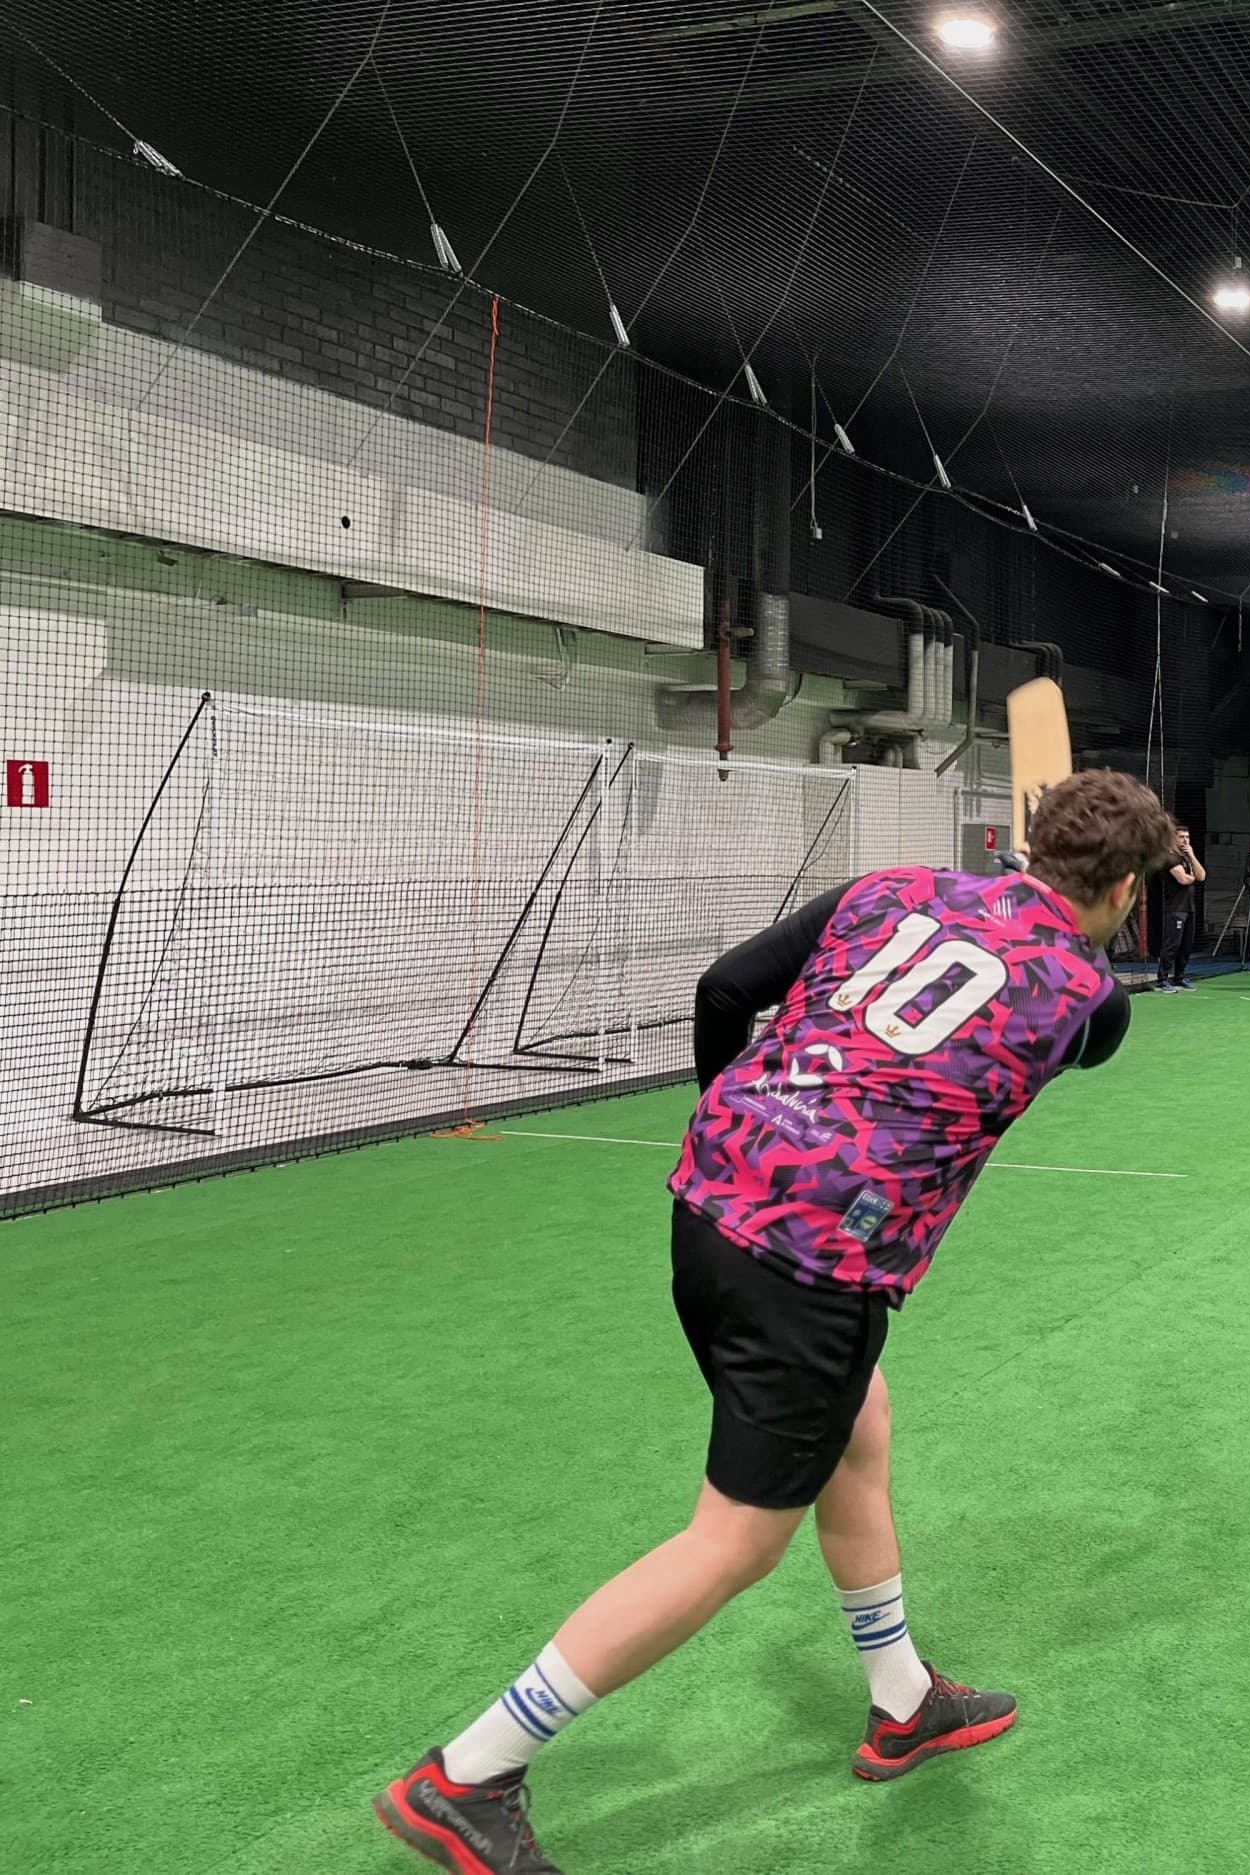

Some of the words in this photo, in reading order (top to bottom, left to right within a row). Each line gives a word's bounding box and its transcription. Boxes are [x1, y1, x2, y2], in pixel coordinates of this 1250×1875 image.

[827, 911, 1009, 1055] 10
[854, 1610, 882, 1623] NIKE
[534, 1690, 559, 1714] NIKE
